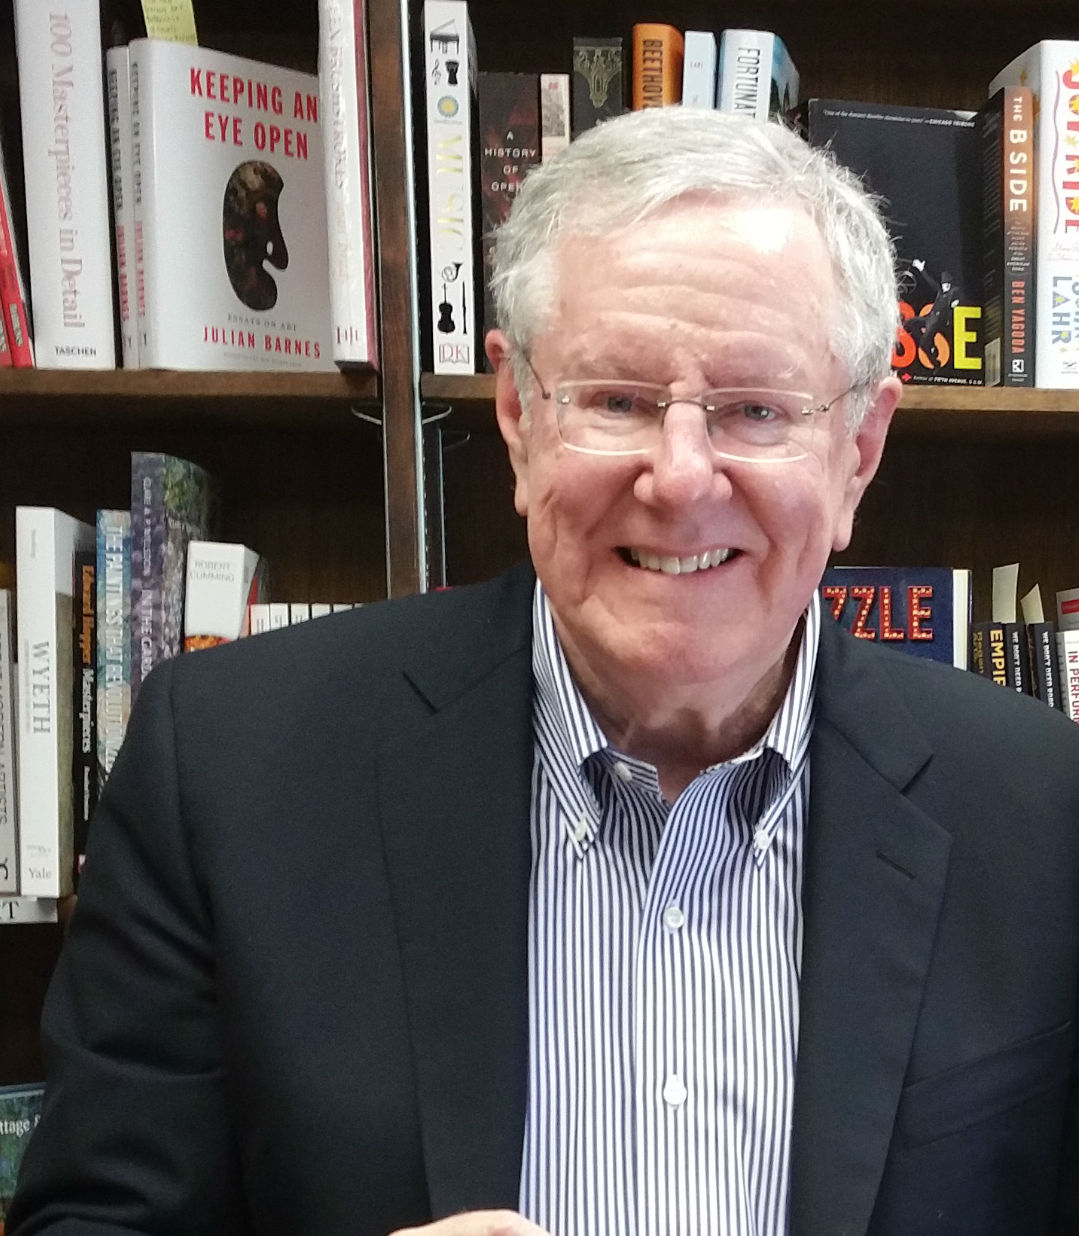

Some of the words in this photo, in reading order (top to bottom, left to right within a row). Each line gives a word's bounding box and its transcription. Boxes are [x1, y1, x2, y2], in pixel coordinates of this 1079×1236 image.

[50, 13, 73, 57] 100
[190, 66, 284, 116] KEEPING
[293, 91, 319, 124] AN
[1013, 96, 1023, 121] THE
[48, 63, 77, 221] Masterpieces
[204, 111, 244, 147] EYE
[253, 121, 309, 161] OPEN
[506, 130, 514, 141] A
[1010, 129, 1028, 144] B
[484, 148, 537, 159] HISTORY
[503, 165, 519, 175] OF
[1010, 151, 1028, 212] SIDE
[60, 228, 78, 251] in
[61, 258, 86, 328] Detail
[1011, 280, 1025, 303] BEN
[1051, 275, 1072, 345] LAHR
[203, 325, 257, 350] JULIAN
[264, 333, 322, 360] BARNES
[1011, 308, 1025, 354] YAGODA
[55, 345, 97, 356] TASCHEN
[105, 525, 123, 551] THE
[105, 553, 123, 626] PAINTINGS
[141, 589, 153, 605] IN
[141, 609, 153, 634] THE
[105, 628, 123, 663] THAT
[1068, 651, 1078, 663] IN
[32, 641, 51, 734] WYETH
[79, 667, 95, 753] Masterpieces
[28, 867, 52, 879] Yale
